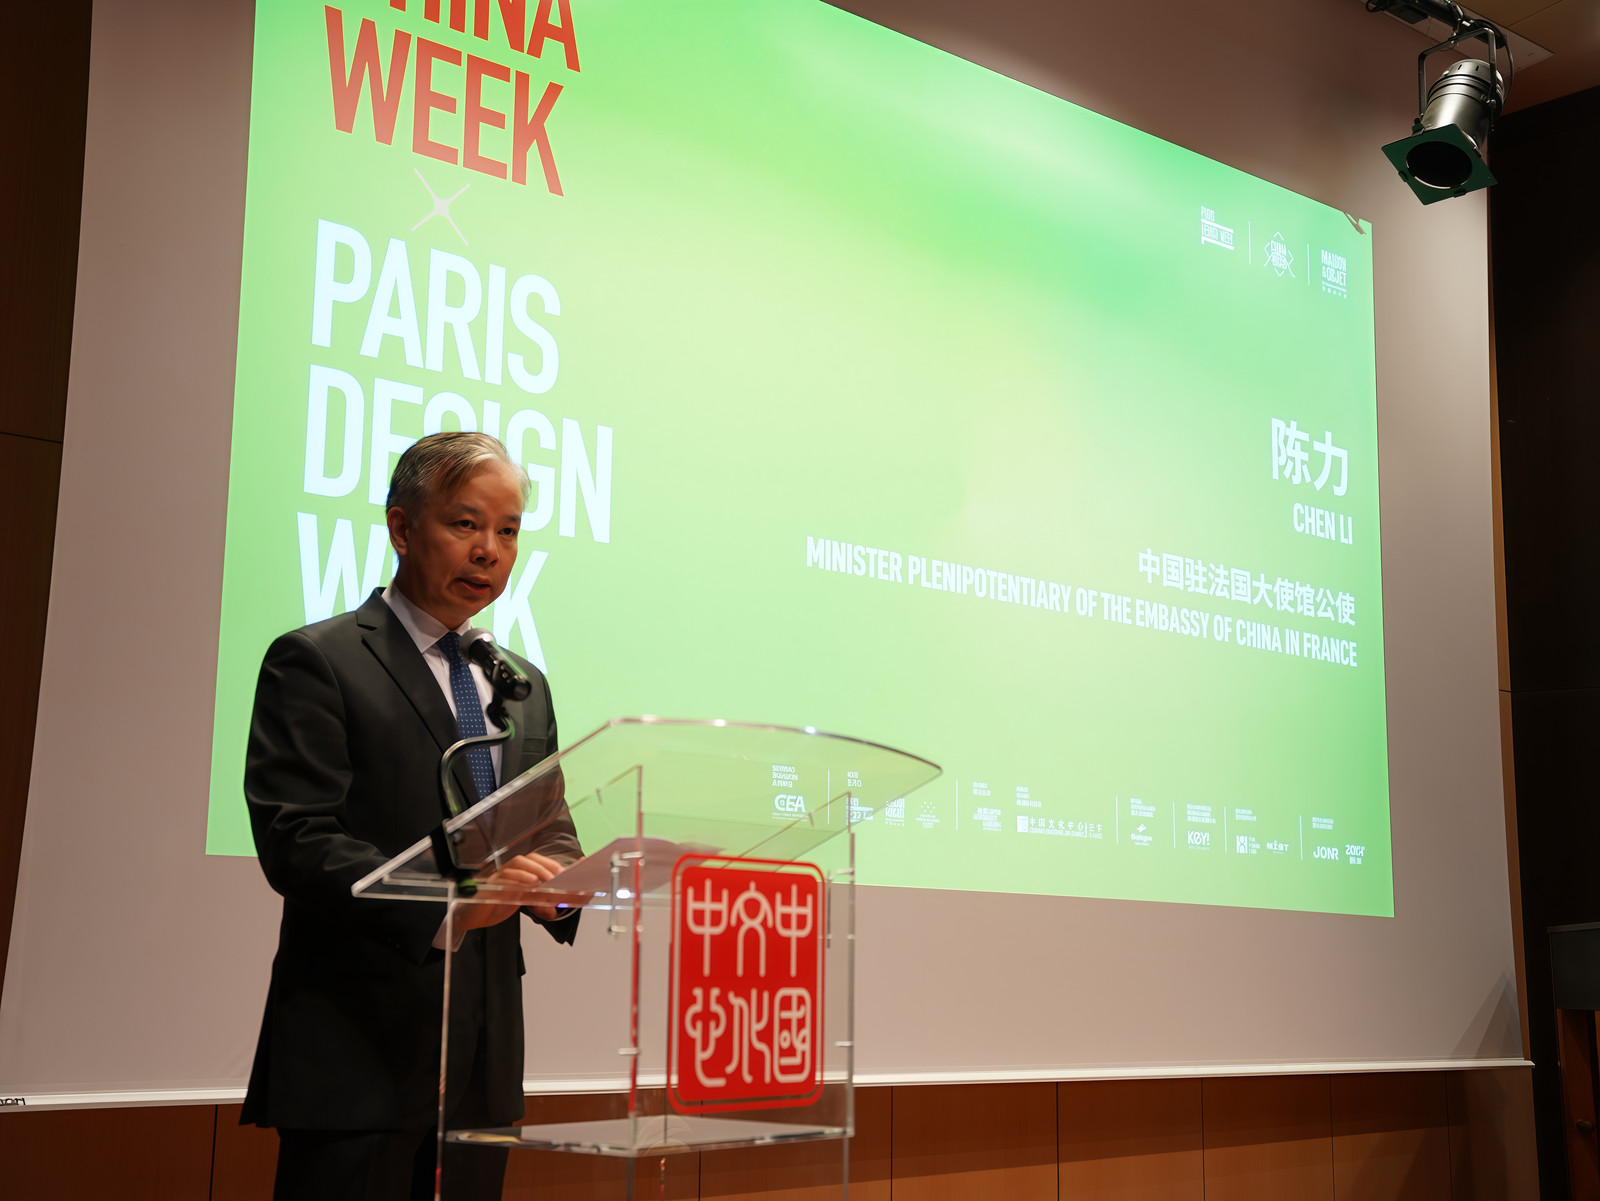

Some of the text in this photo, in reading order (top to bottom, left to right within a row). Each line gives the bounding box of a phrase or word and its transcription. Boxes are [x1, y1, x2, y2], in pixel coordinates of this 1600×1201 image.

[325, 5, 564, 197] WEEK
[311, 218, 561, 394] PARIS
[1271, 417, 1349, 496] 陈力
[1138, 548, 1356, 626] 中国驻法国大使馆公使
[1293, 503, 1353, 545] CHEN LI
[297, 512, 549, 675] WK
[806, 536, 1357, 667] MINISTER PLENIPOTENTIARY OF THE EMBASSY OF CHINA IN FRANCE
